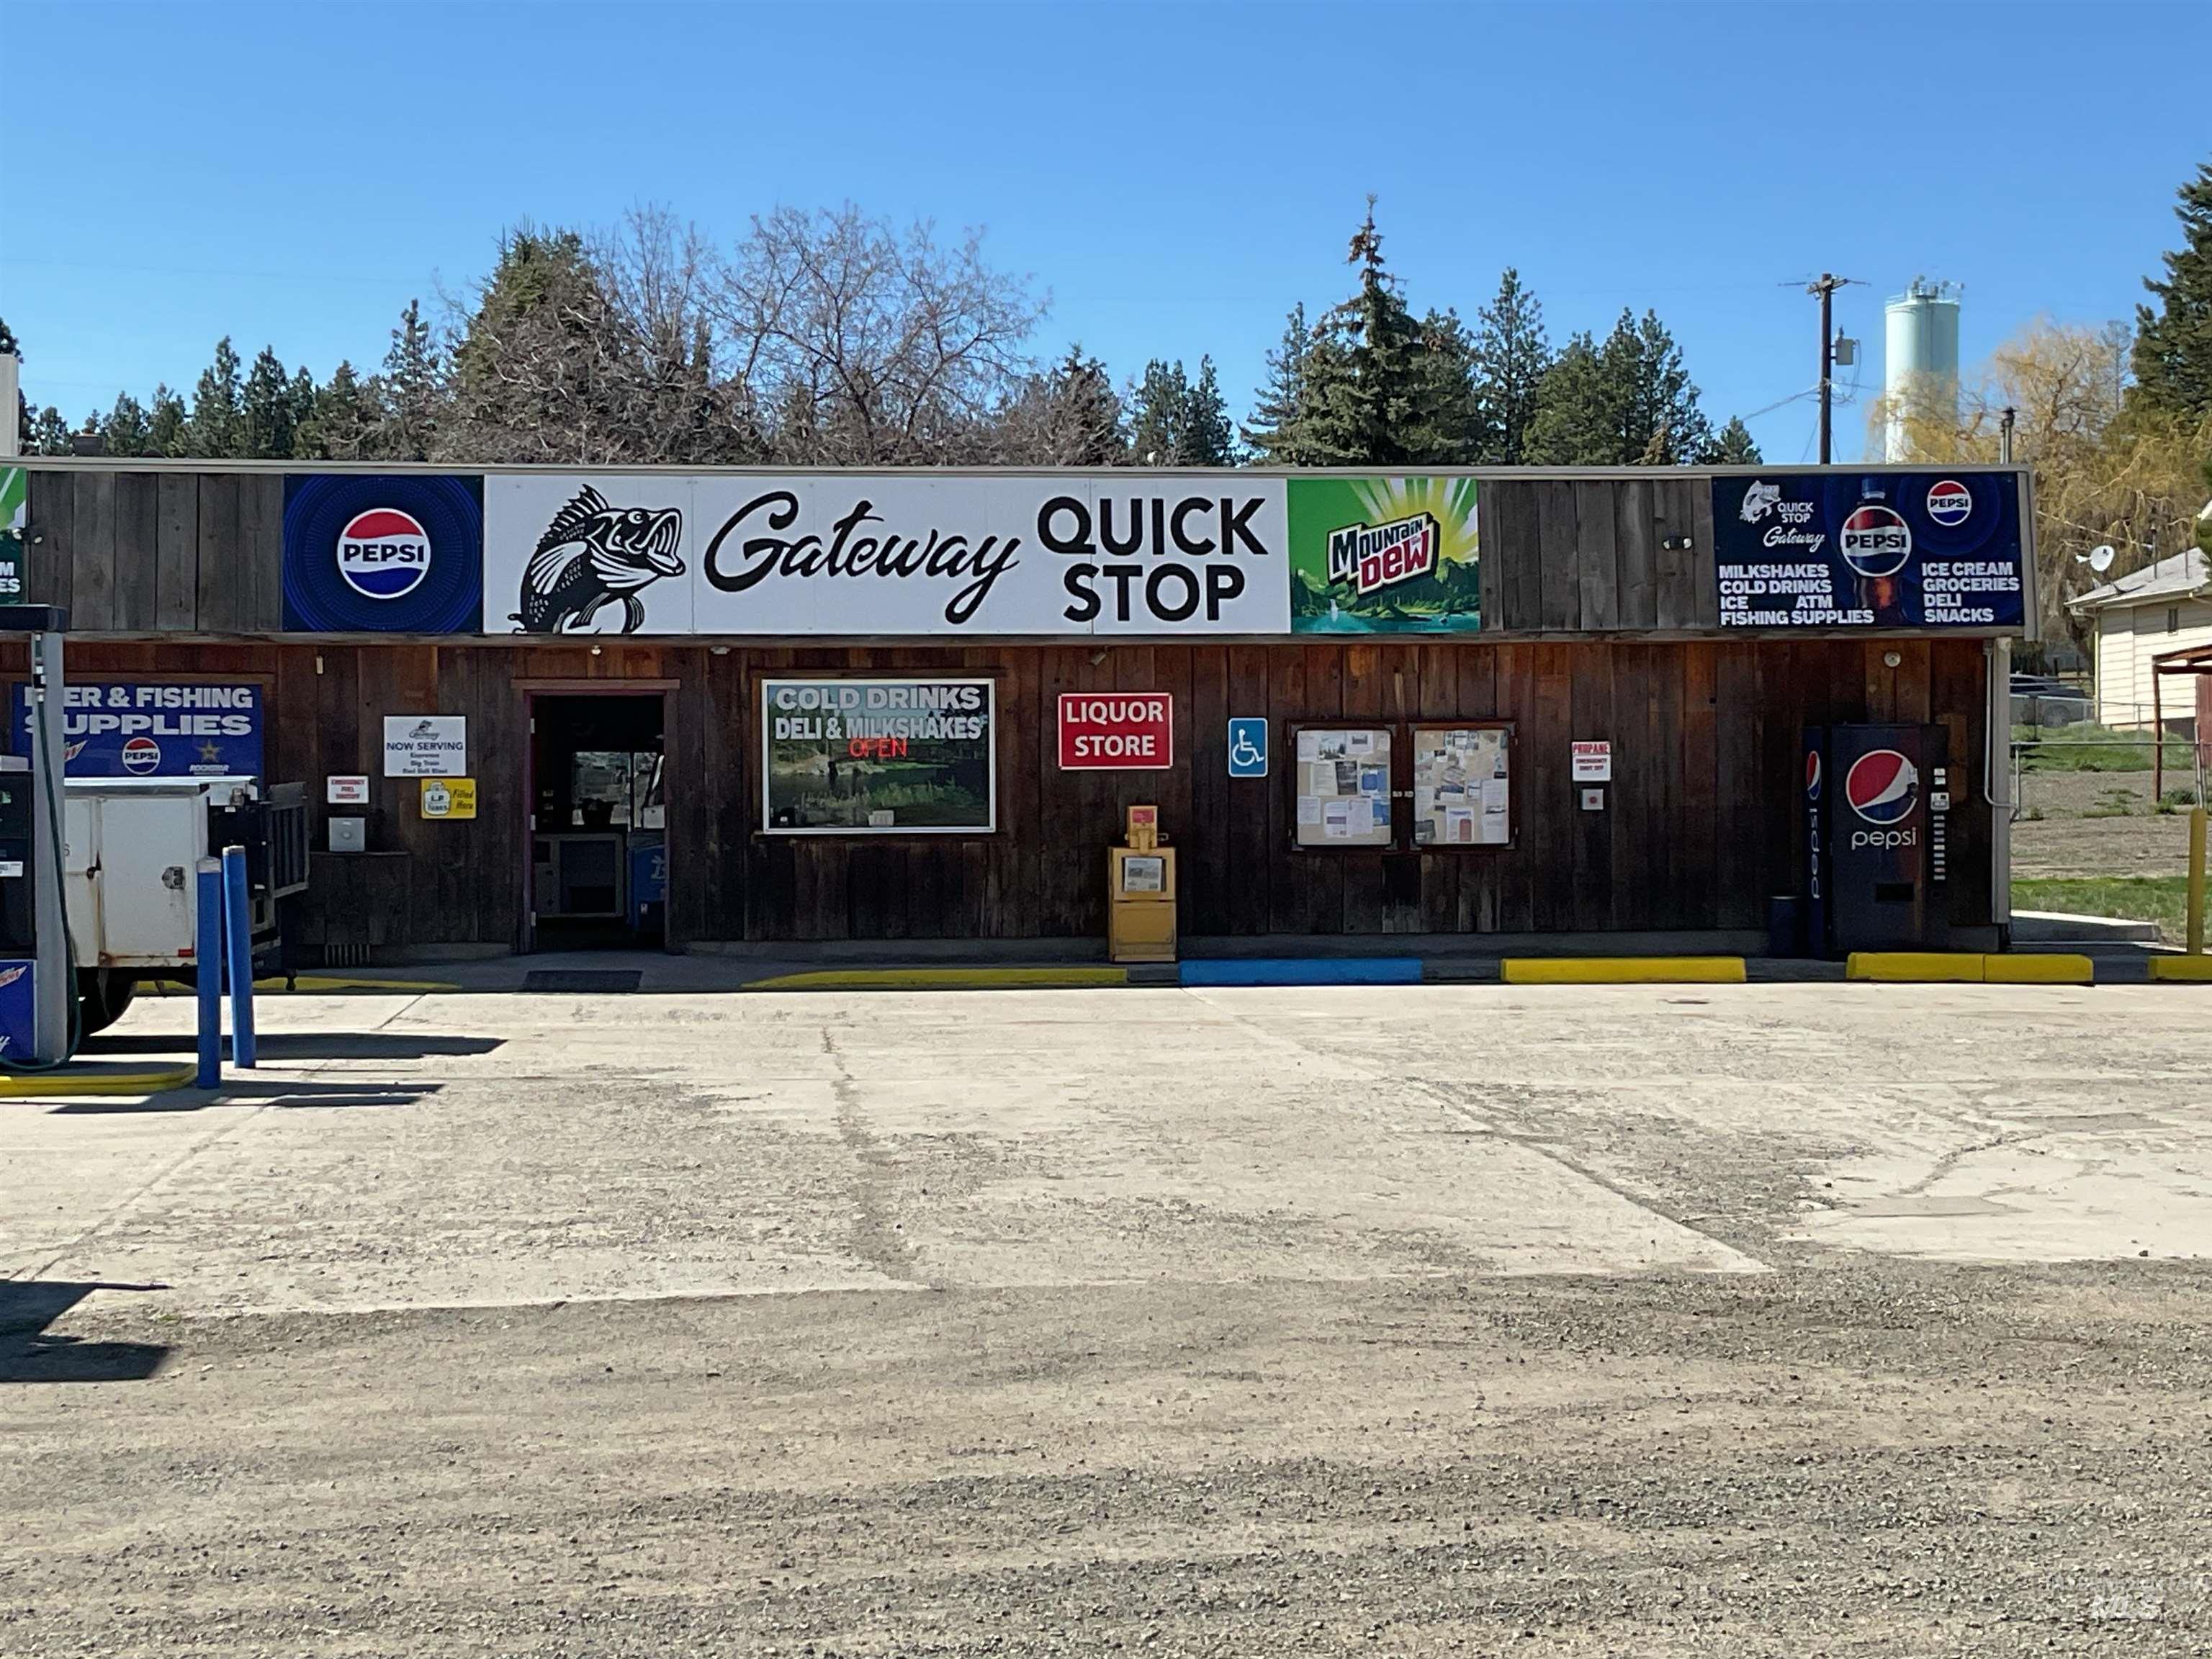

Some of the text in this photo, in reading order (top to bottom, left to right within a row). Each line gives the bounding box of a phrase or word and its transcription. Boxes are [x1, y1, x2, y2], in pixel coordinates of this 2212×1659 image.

[1777, 503, 1814, 513] QUICK
[1930, 498, 1968, 508] PEPSI
[1037, 496, 1268, 555] QUICK
[1781, 513, 1811, 523] STOP
[1763, 526, 1825, 552] Gateway
[1845, 534, 1907, 549] PEPSI
[343, 544, 423, 562] PEPSI
[704, 491, 1021, 625] Gateway
[1719, 565, 1829, 579] MILKSHAKES
[1922, 562, 2013, 576] ICE CREAM
[1063, 563, 1245, 622] STOP
[1719, 580, 1833, 594] COLD DRINKS
[1923, 577, 2020, 592] GROCERIES
[1720, 596, 1749, 609] ICE
[1796, 595, 1833, 608] ATM
[1923, 593, 1961, 607] DELI
[1720, 610, 1874, 625] FISHING SUPPLIES
[1925, 608, 1994, 623] SNACKS
[107, 687, 131, 708] &
[136, 688, 253, 709] FISHING
[776, 687, 981, 709] COLD DRINKS
[1066, 701, 1164, 725] LIQUOR
[775, 716, 981, 739] DELI & MILKSHAKES
[848, 737, 907, 757] OPEN
[1074, 735, 1155, 756] STORE
[1851, 827, 1916, 850] pepsi
[1809, 808, 1820, 899] pepsi
